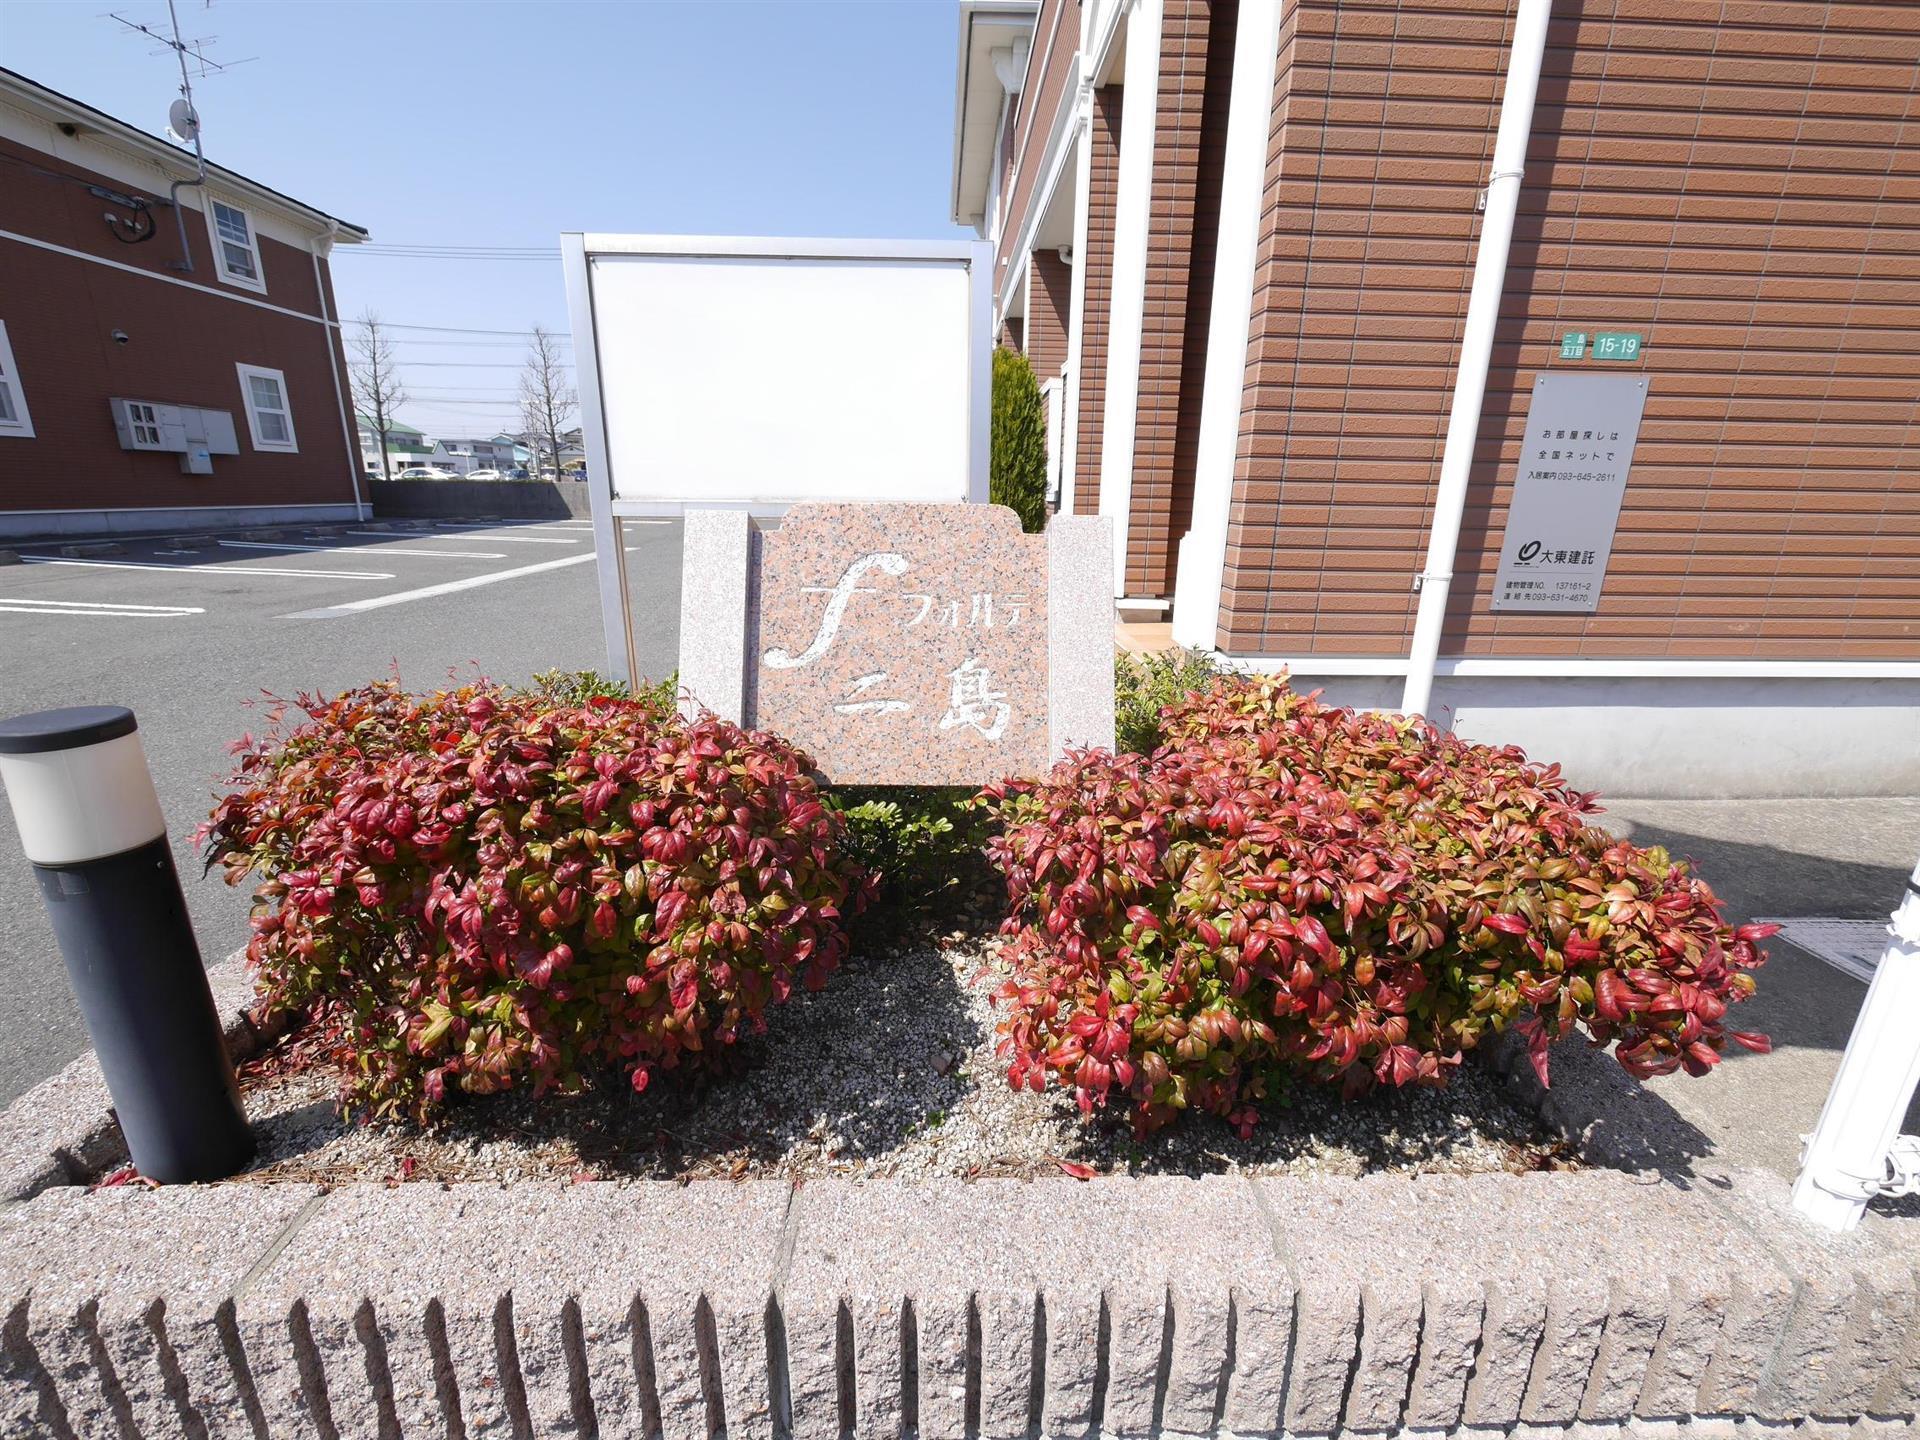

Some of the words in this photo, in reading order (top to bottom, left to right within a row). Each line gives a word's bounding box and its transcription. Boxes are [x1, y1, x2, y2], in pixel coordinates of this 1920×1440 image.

[1600, 338, 1637, 353] 15-19
[1542, 430, 1618, 441] お部屋探しは
[1538, 450, 1615, 461] 全国ネットで
[1540, 550, 1595, 564] 大東建託
[833, 657, 1010, 740] 二島
